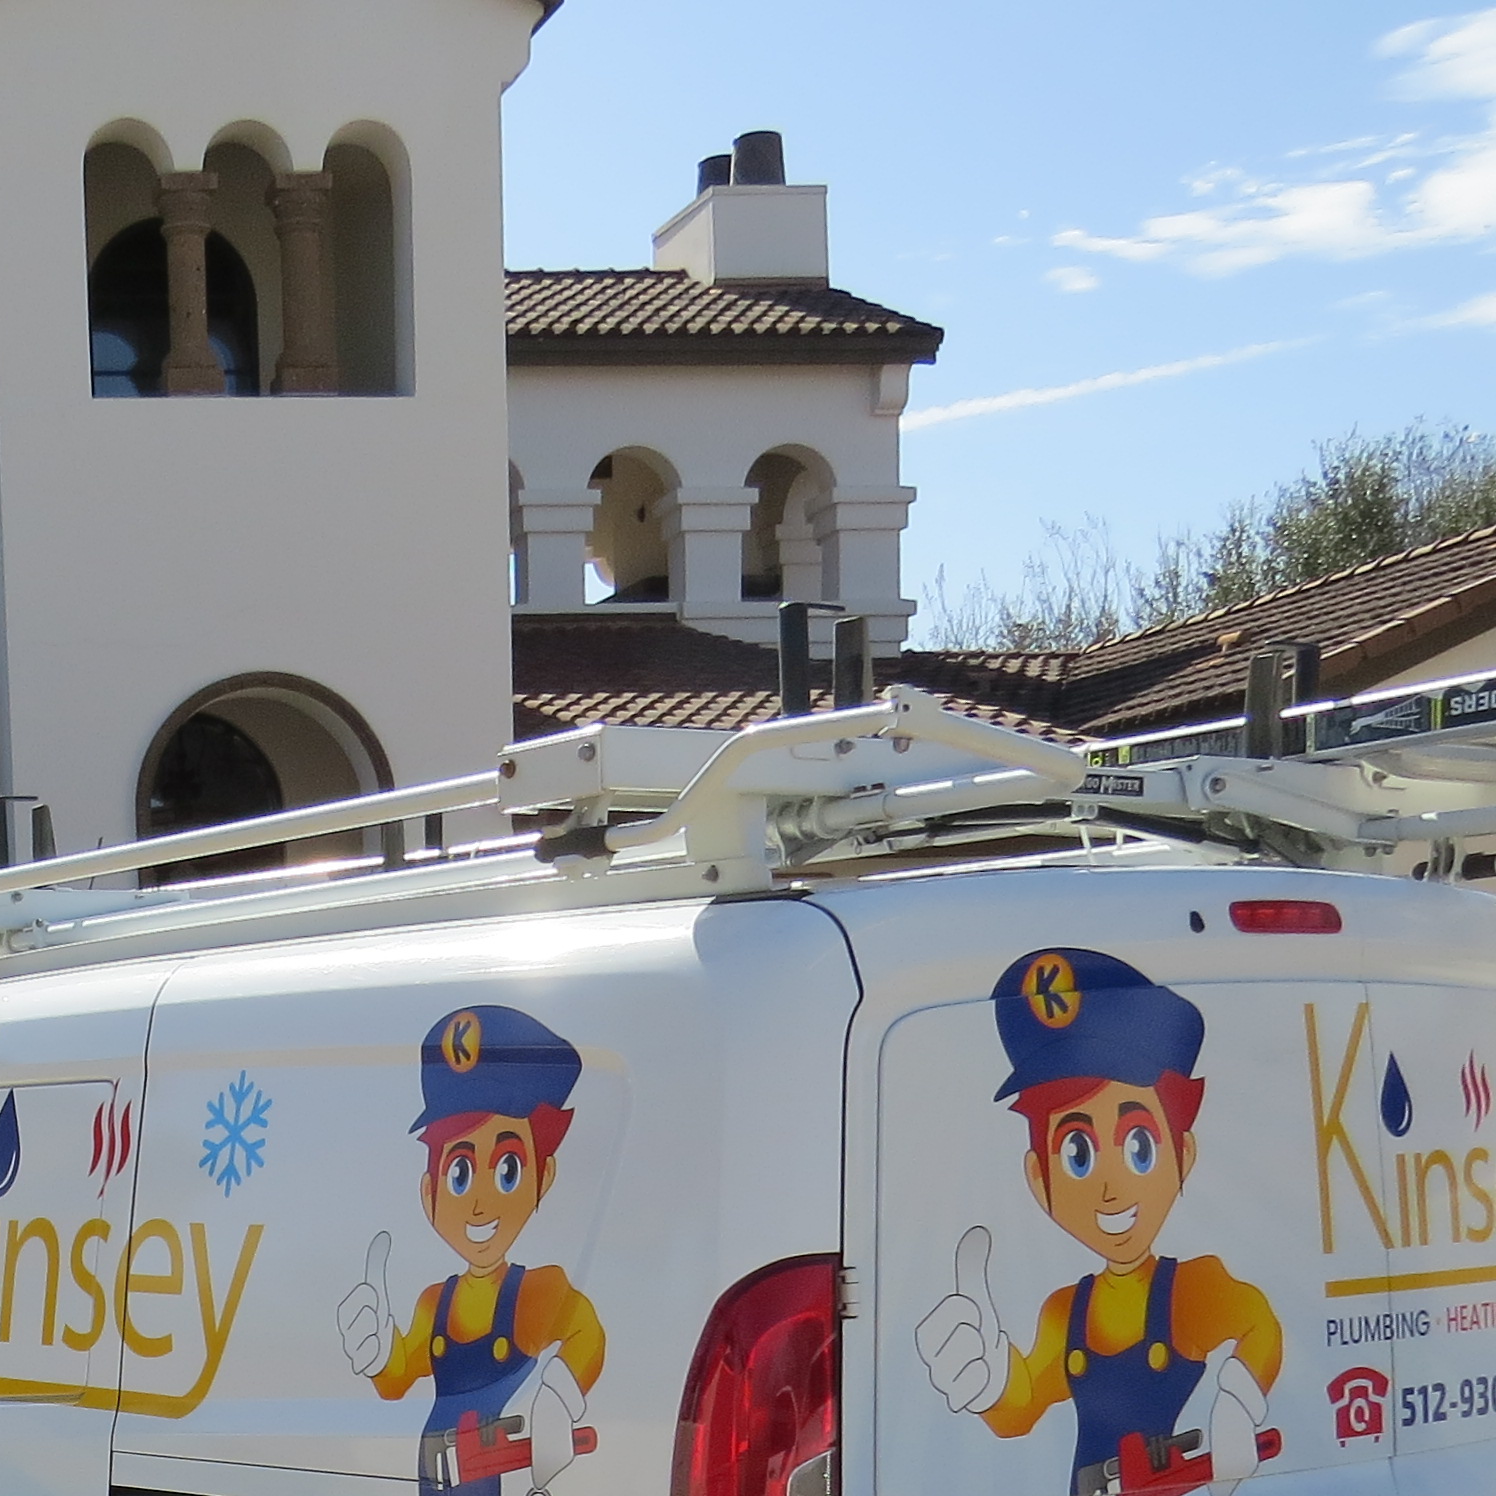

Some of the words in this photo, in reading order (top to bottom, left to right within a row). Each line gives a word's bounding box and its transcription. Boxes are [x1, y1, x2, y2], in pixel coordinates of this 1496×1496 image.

[1036, 964, 1069, 1018] K
[452, 1020, 471, 1065] K
[1326, 1310, 1431, 1347] PLUMBING
